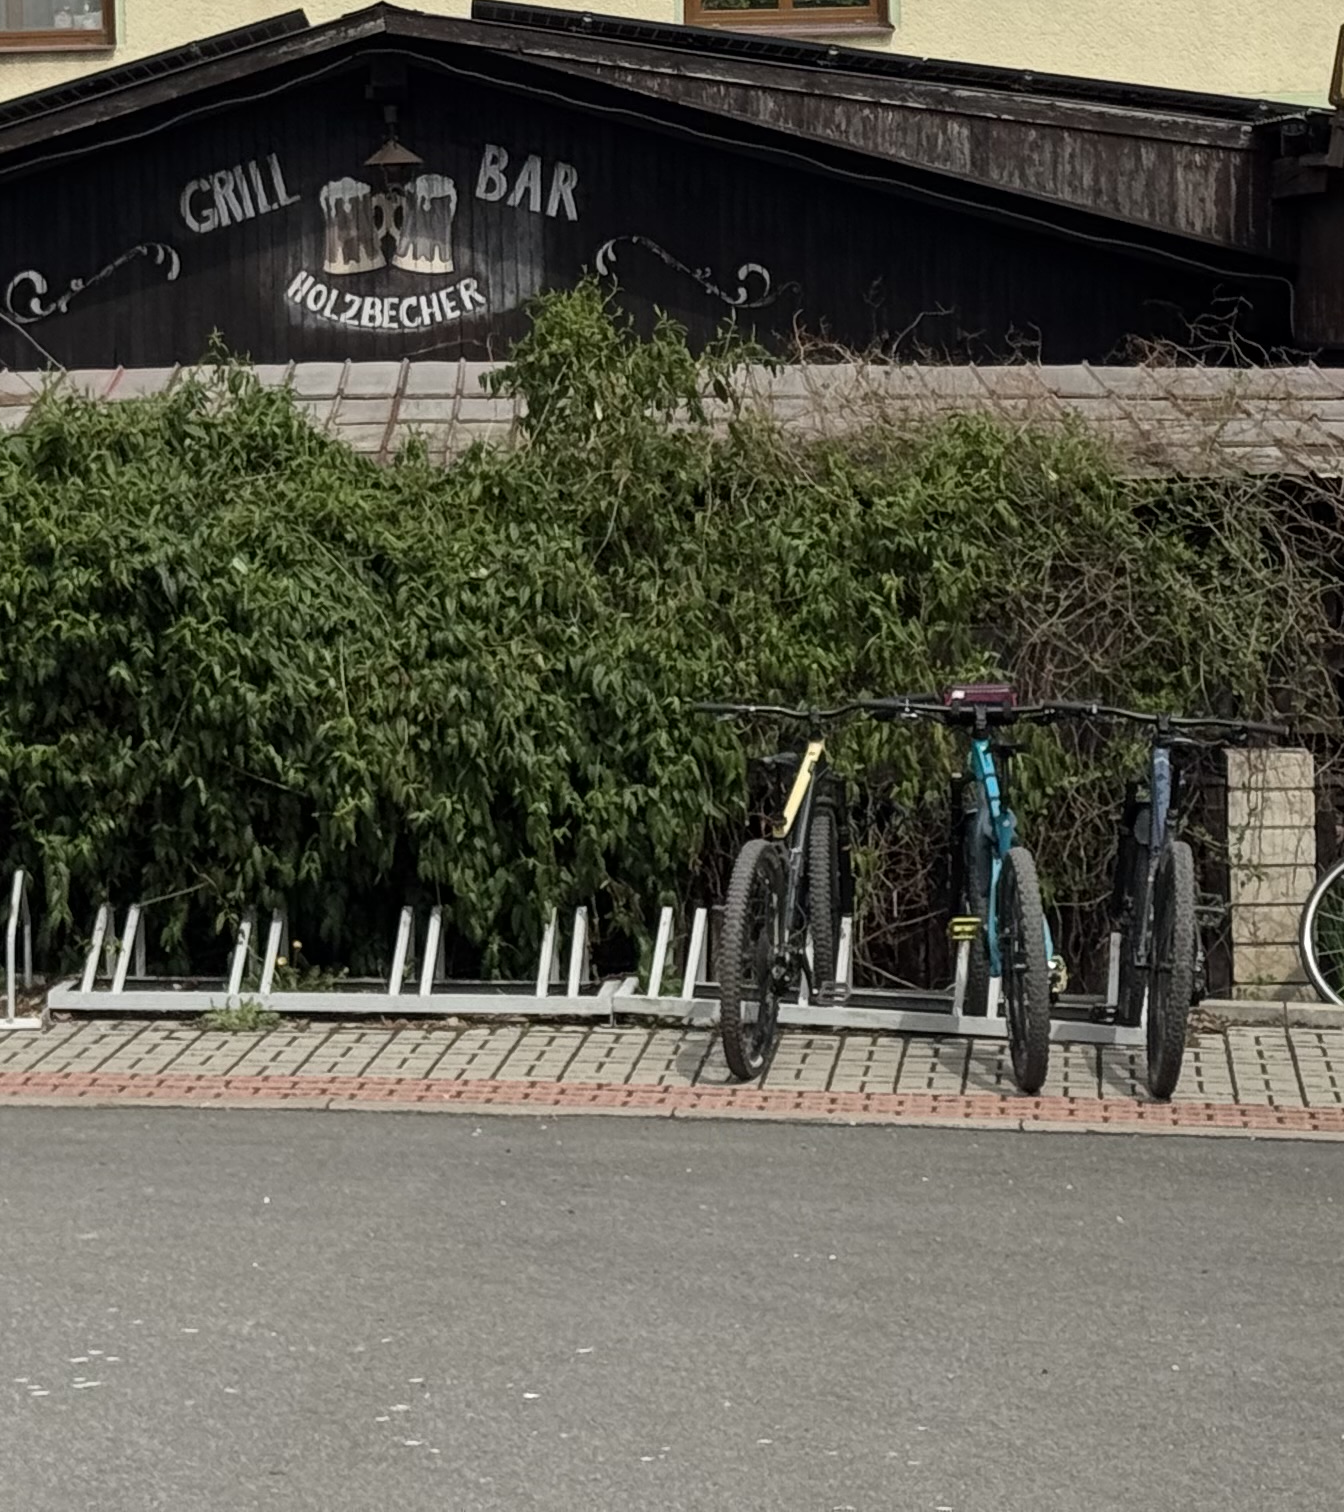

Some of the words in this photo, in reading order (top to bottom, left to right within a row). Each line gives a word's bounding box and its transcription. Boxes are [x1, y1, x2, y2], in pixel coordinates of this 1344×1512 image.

[179, 152, 301, 234] GRILL
[474, 143, 579, 222] BAR
[286, 269, 487, 330] HOLZBECHER
